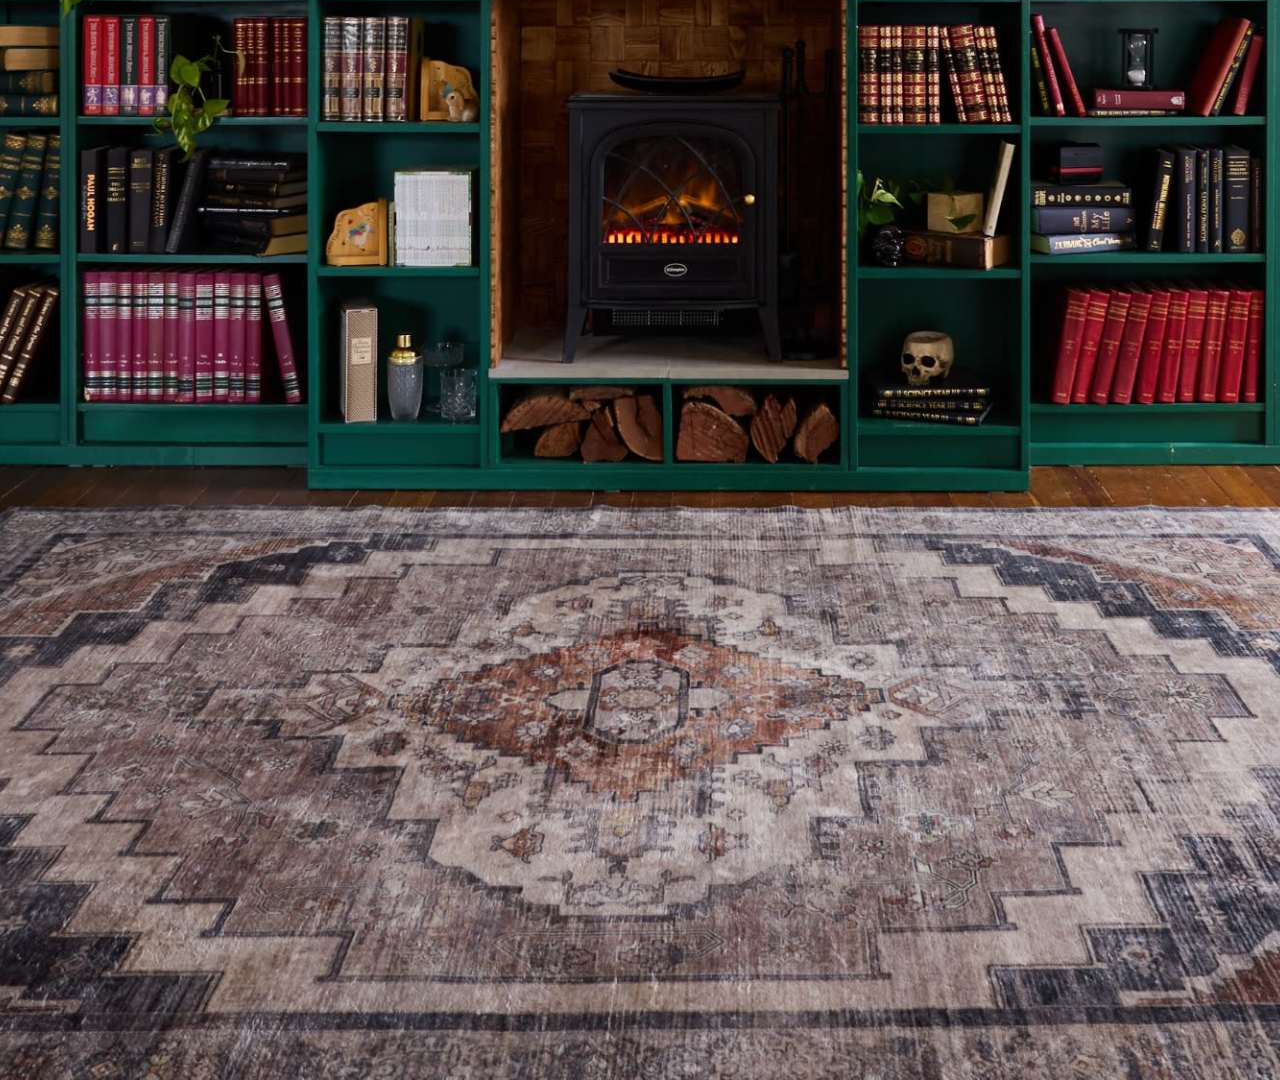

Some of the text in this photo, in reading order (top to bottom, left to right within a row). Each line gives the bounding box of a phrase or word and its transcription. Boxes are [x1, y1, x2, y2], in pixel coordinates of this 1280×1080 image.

[86, 174, 96, 231] PAUL HOGAN
[1091, 213, 1104, 229] My
[1102, 211, 1111, 230] Life
